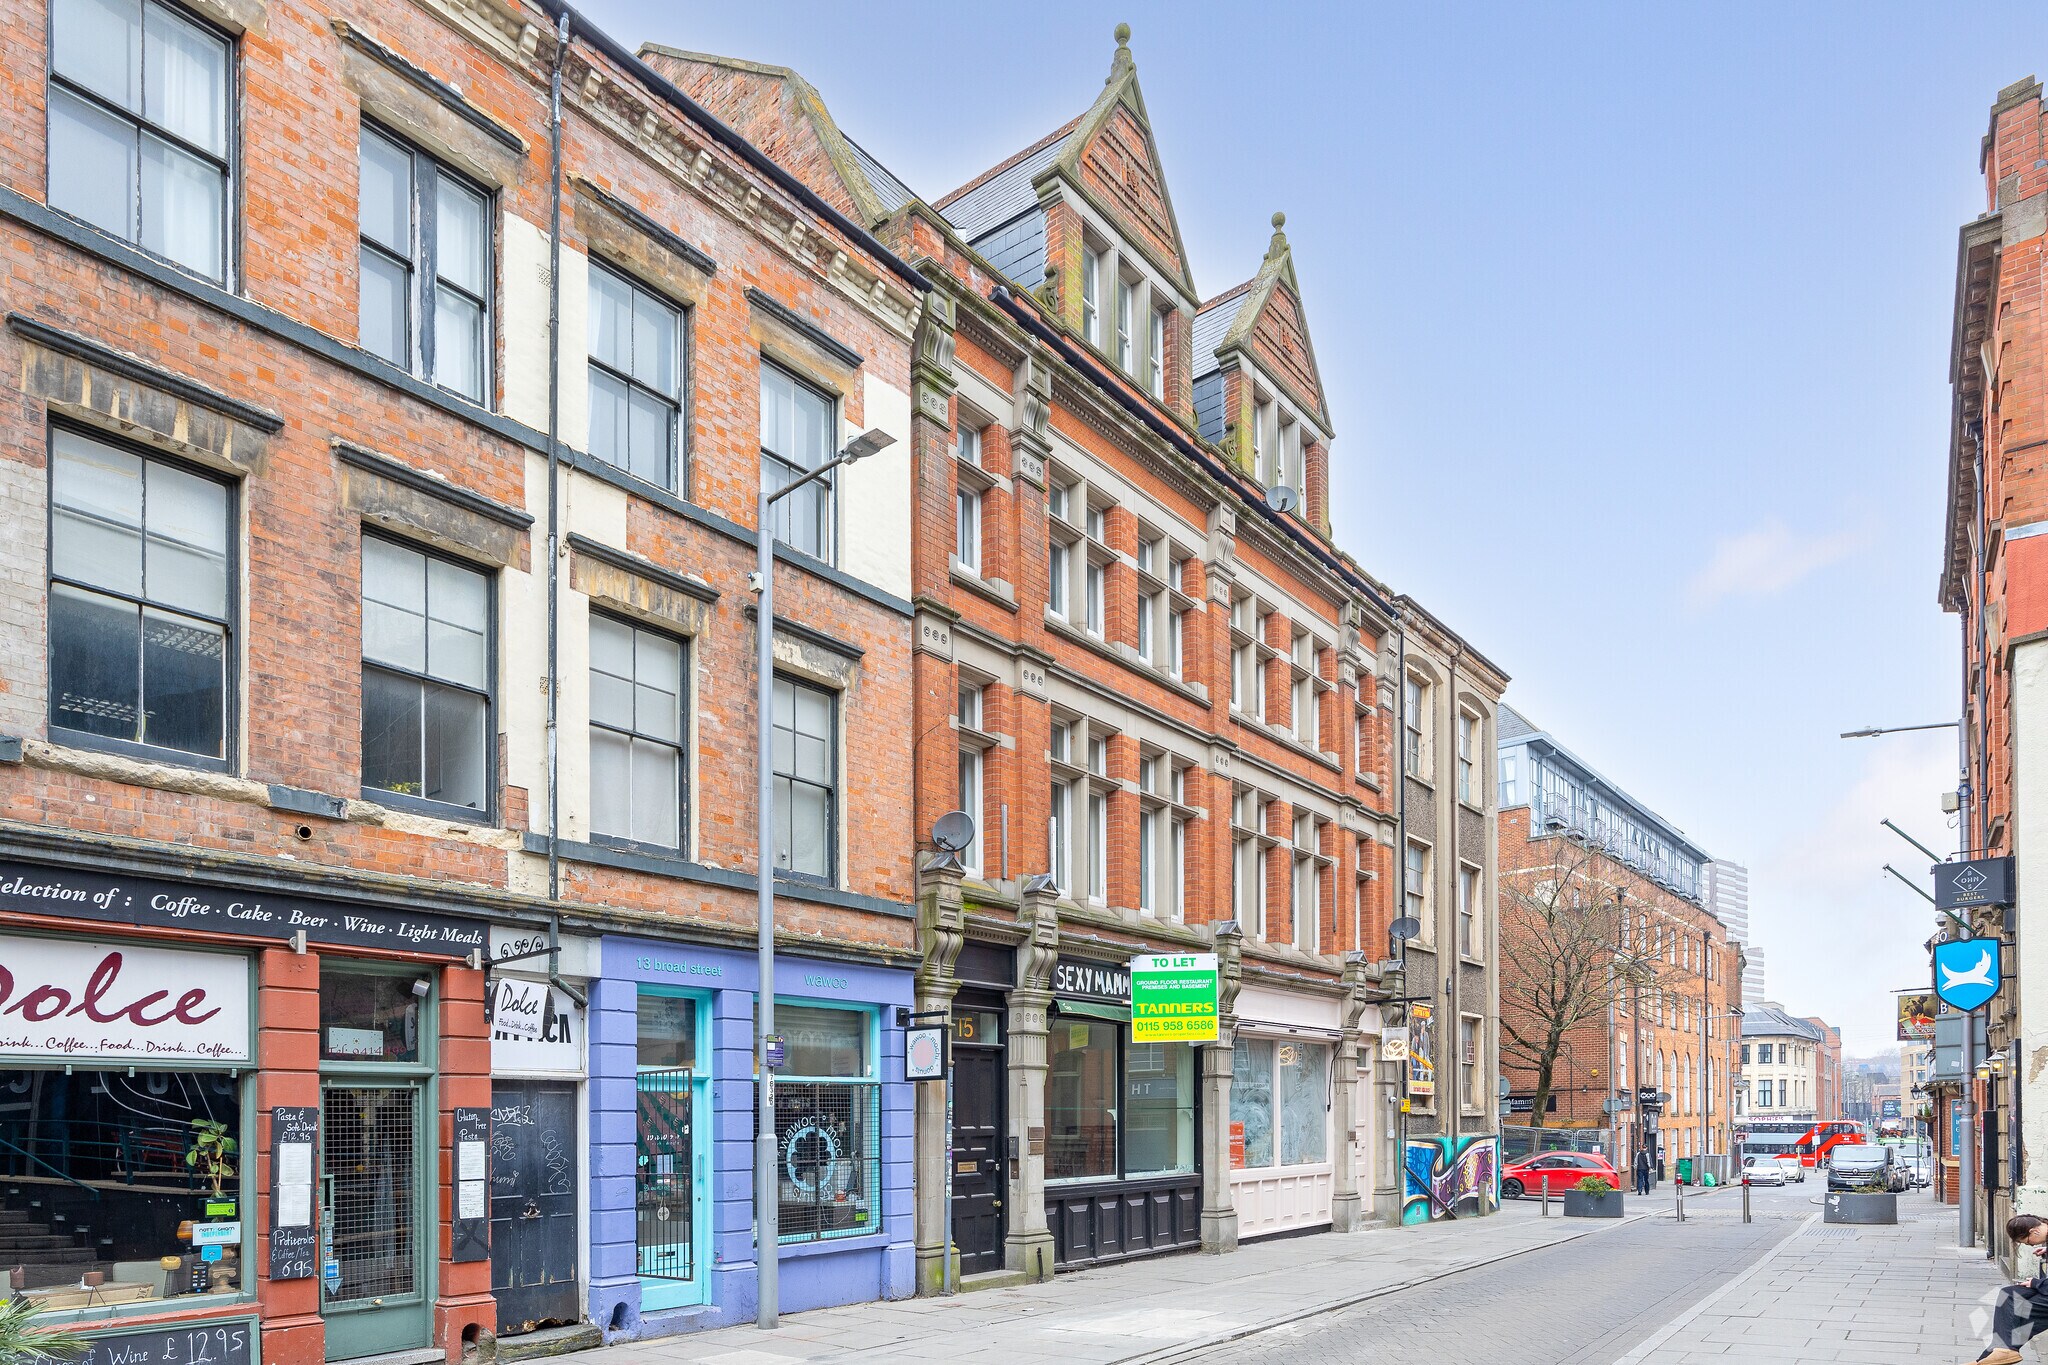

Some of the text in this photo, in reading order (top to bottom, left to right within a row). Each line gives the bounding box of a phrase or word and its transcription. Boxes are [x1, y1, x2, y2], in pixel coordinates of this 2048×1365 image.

[93, 888, 120, 910] of
[150, 894, 211, 918] Coffee
[227, 902, 273, 922] Cake
[288, 910, 328, 928] Beer
[343, 915, 386, 935] Wine
[396, 922, 438, 943] Light
[439, 927, 483, 945] Meals
[636, 957, 722, 976] 13 broad street
[1152, 957, 1197, 968] TO LET
[804, 973, 849, 989] wawoo
[1056, 965, 1093, 993] SEXY
[501, 983, 538, 1015] Dolce
[957, 1017, 974, 1038] 15
[1136, 1020, 1214, 1031] 0115 958 6586
[909, 1033, 927, 1050] wawoo
[276, 1108, 297, 1121] Pasta
[457, 1108, 478, 1122] Gluten
[302, 1121, 318, 1132] Drink
[458, 1129, 478, 1141] Pasta
[108, 1345, 149, 1365] Wine
